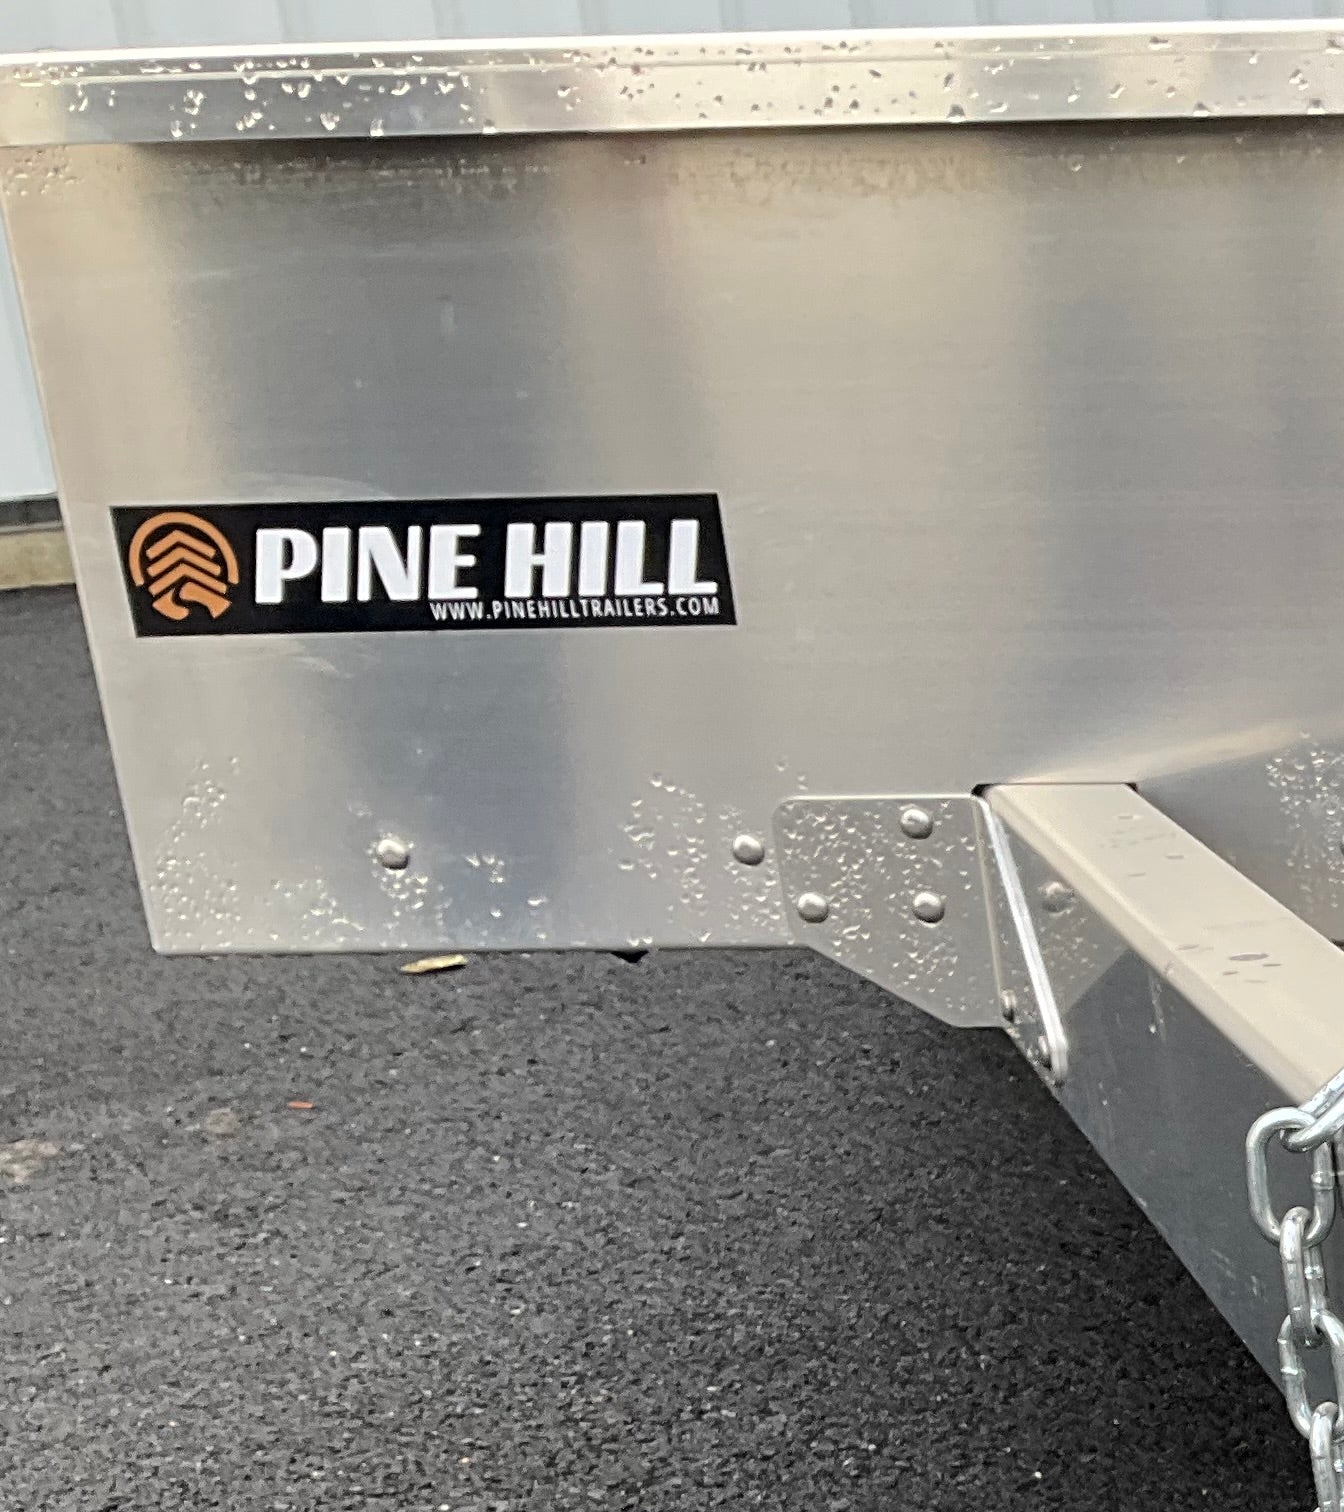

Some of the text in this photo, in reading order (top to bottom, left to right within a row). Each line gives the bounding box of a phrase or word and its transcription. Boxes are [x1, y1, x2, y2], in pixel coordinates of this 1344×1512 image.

[255, 519, 718, 603] PINE HILL
[429, 597, 719, 623] WWW.PINEHILLTRAILERS.COM
